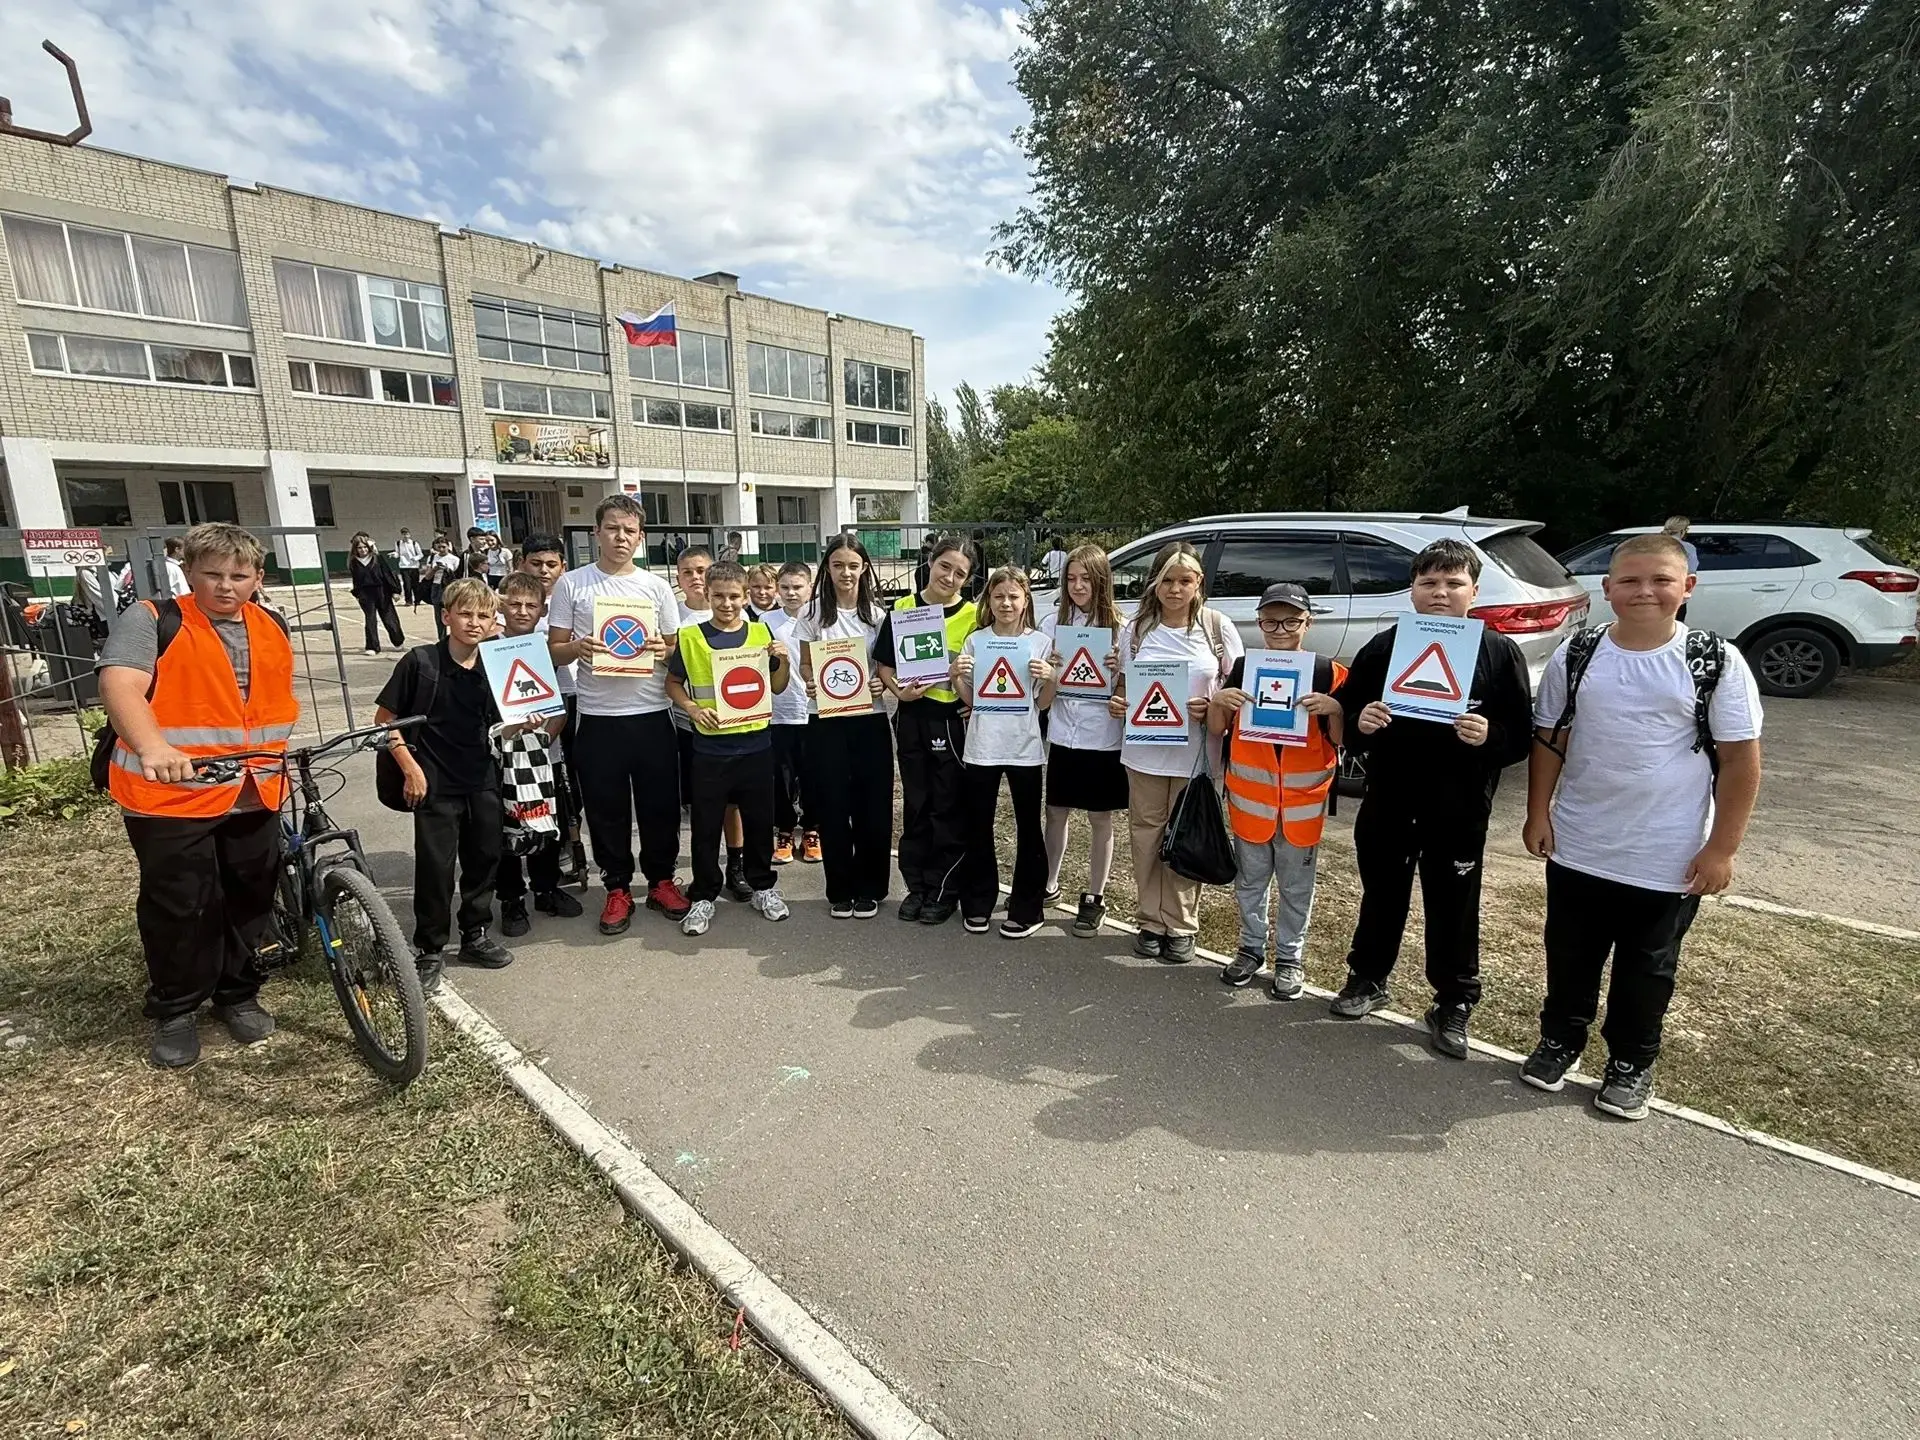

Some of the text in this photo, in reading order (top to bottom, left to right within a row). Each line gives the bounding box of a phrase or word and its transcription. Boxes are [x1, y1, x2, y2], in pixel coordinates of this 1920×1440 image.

[28, 539, 99, 549] ЗАПРЕЩЕН
[1415, 620, 1465, 630] ИСКУССТВЕННАЯ
[1420, 627, 1458, 635] НЕРОВНОСТЬ
